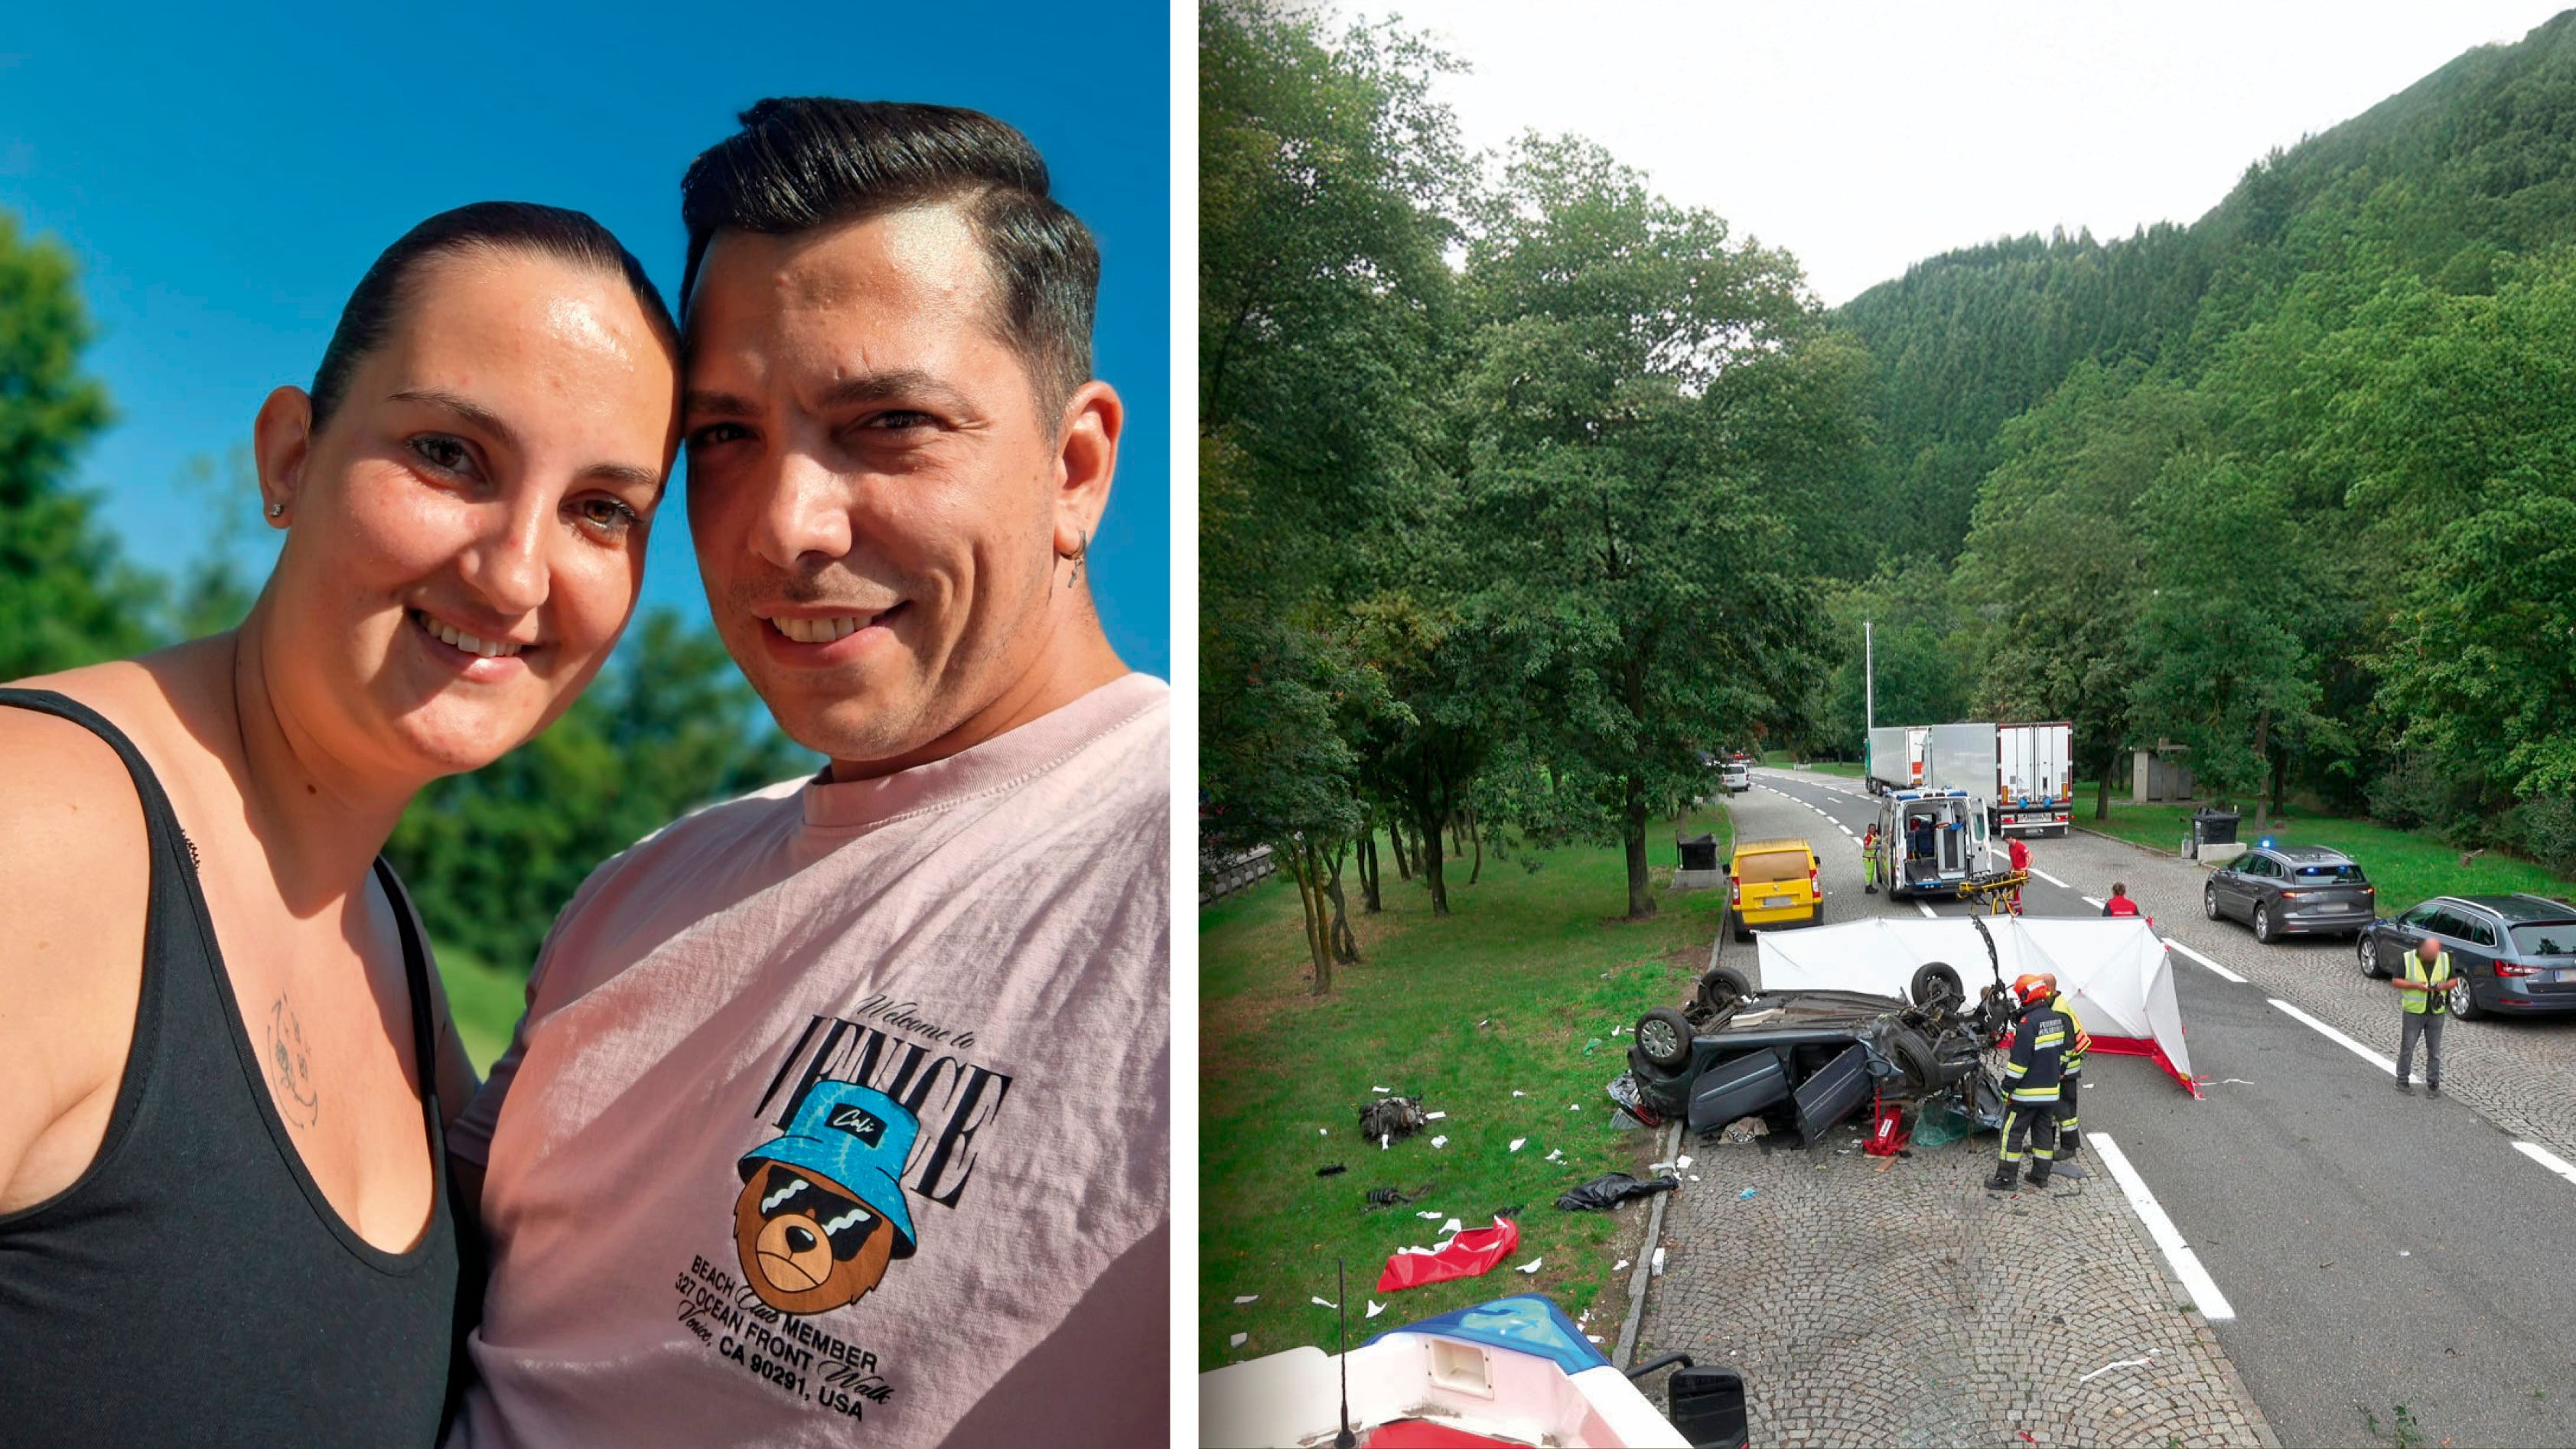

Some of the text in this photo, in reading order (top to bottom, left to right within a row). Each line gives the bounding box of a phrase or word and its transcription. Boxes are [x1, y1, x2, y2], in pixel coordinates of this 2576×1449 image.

[857, 994, 975, 1049] Welcome to
[832, 1109, 874, 1134] Cali
[675, 1272, 895, 1405] 327 OCEAN FRONT Walk
[676, 1299, 863, 1422] Venice, CA 90291, USA
[691, 1255, 878, 1373] BEACH Club MEMBER
